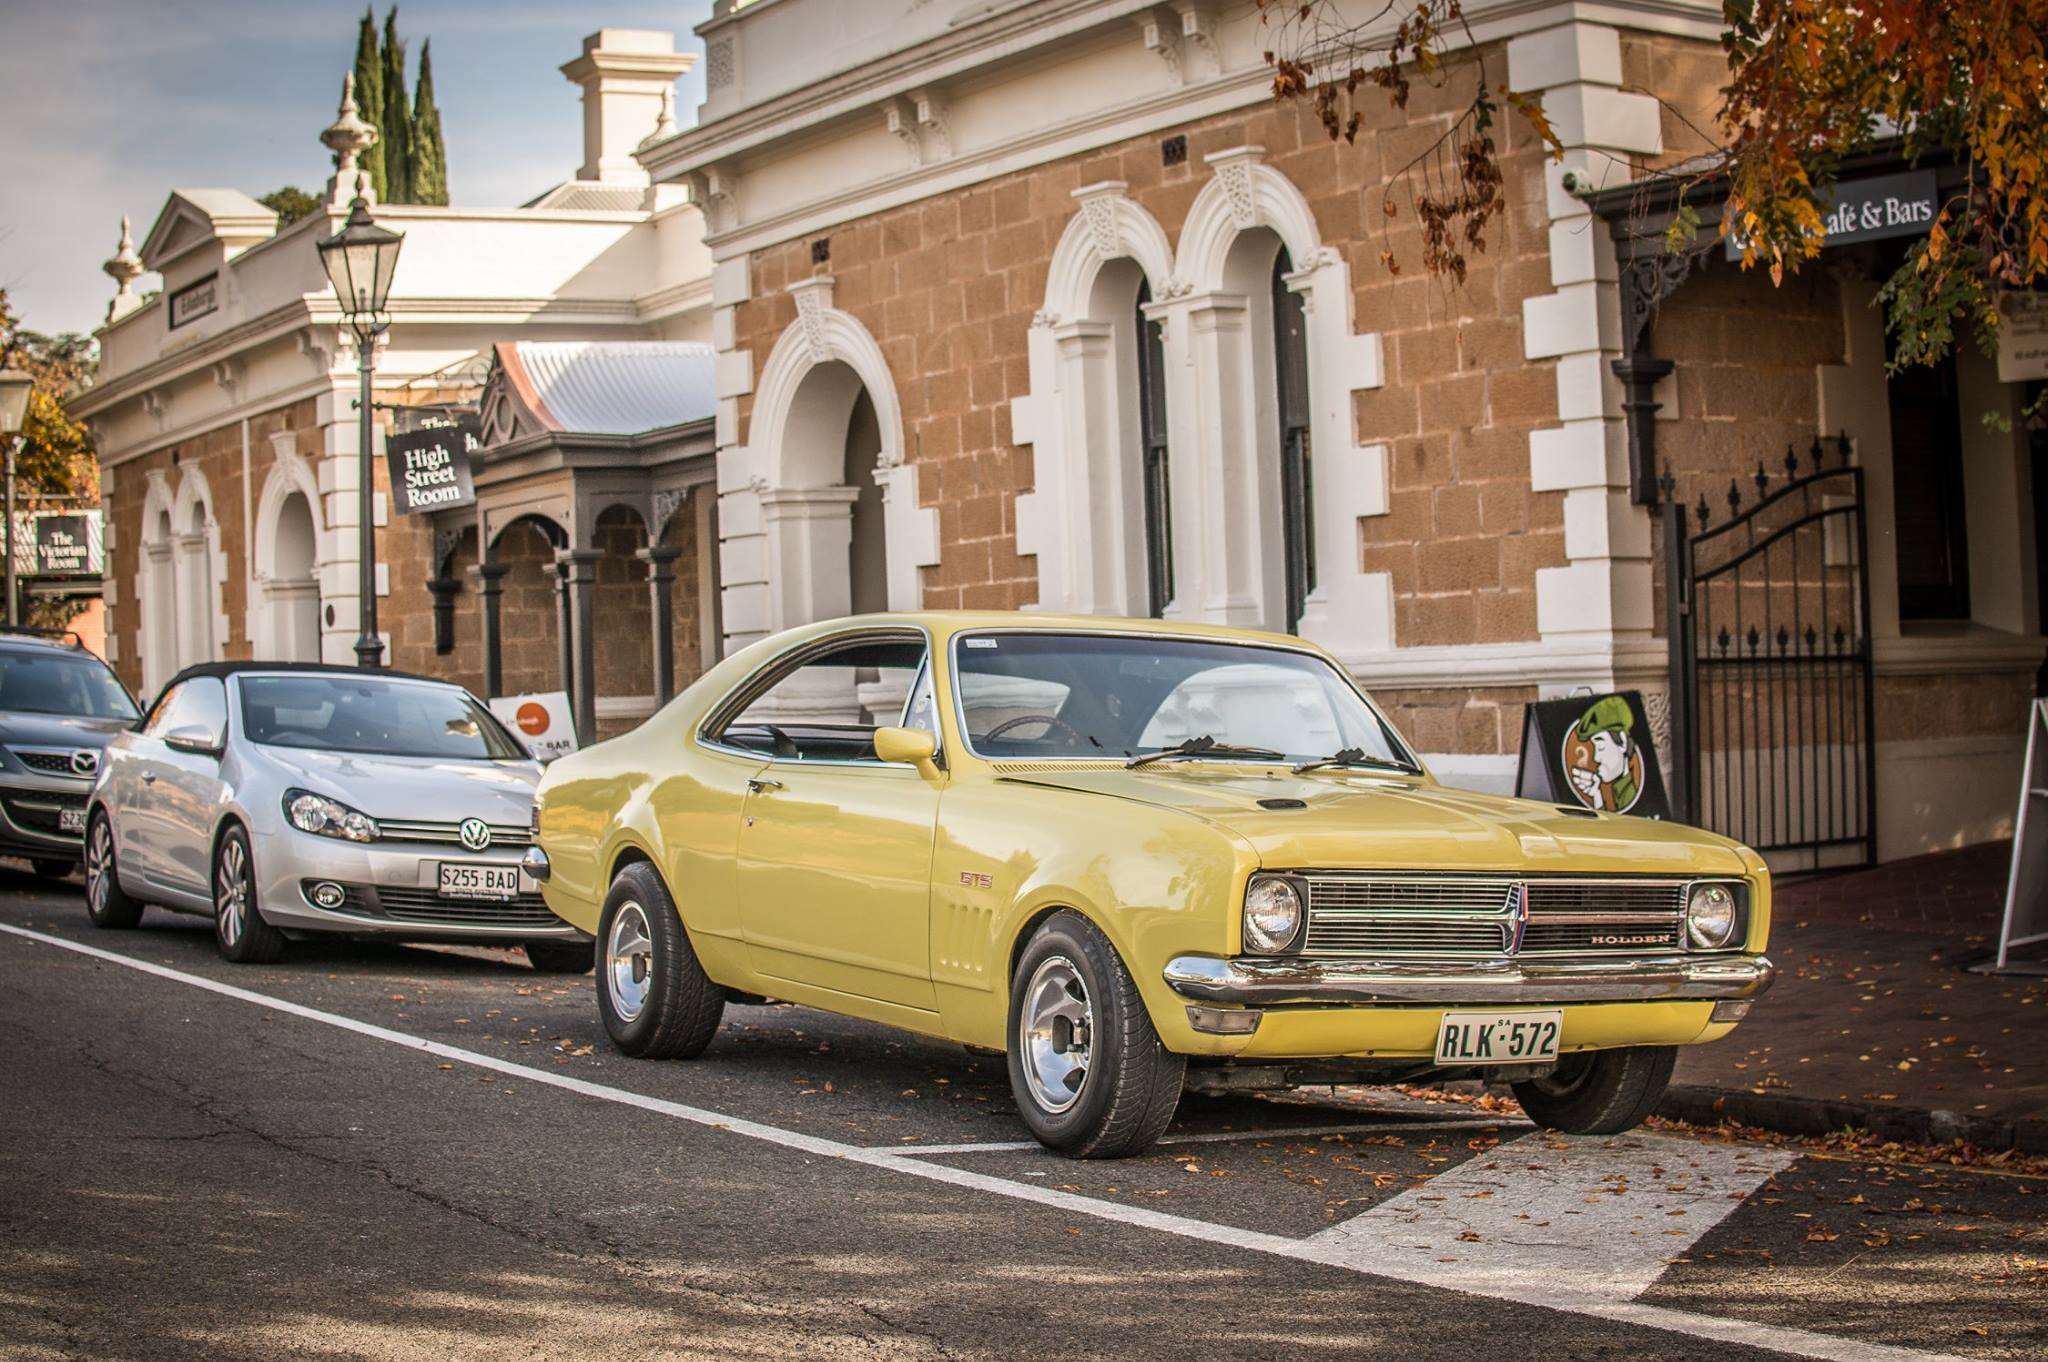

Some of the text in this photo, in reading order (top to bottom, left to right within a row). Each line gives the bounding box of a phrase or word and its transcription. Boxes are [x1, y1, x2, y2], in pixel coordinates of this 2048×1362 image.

[1861, 202, 1882, 228] &
[1885, 197, 1932, 226] Bars
[404, 444, 451, 471] High
[404, 466, 456, 489] Street
[406, 485, 461, 507] Room
[51, 531, 74, 546] The
[39, 544, 88, 557] Victorian
[47, 557, 80, 570] Room
[546, 740, 570, 750] BAR
[1592, 934, 1670, 944] HOLDEN
